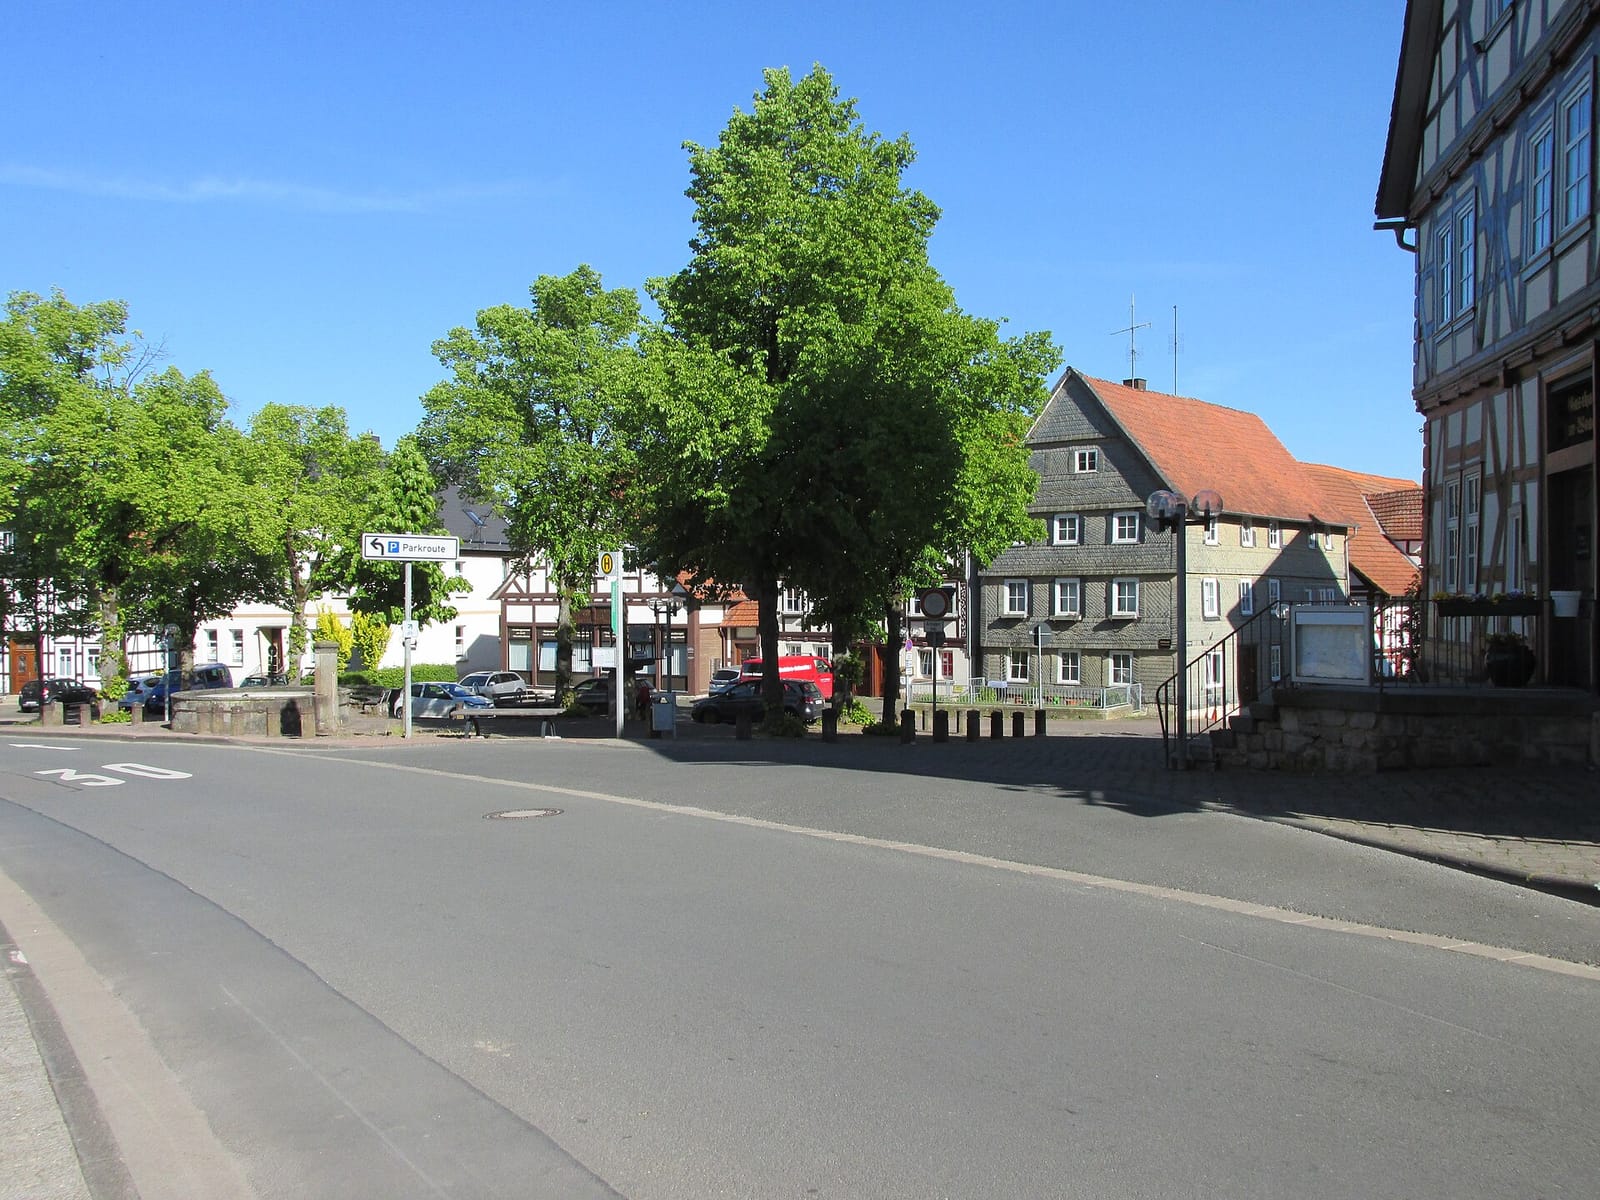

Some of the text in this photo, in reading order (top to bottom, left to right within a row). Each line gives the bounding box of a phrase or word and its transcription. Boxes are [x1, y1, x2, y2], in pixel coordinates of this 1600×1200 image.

[389, 542, 446, 553] P Parkroute
[603, 557, 611, 570] H
[34, 762, 193, 787] 30
